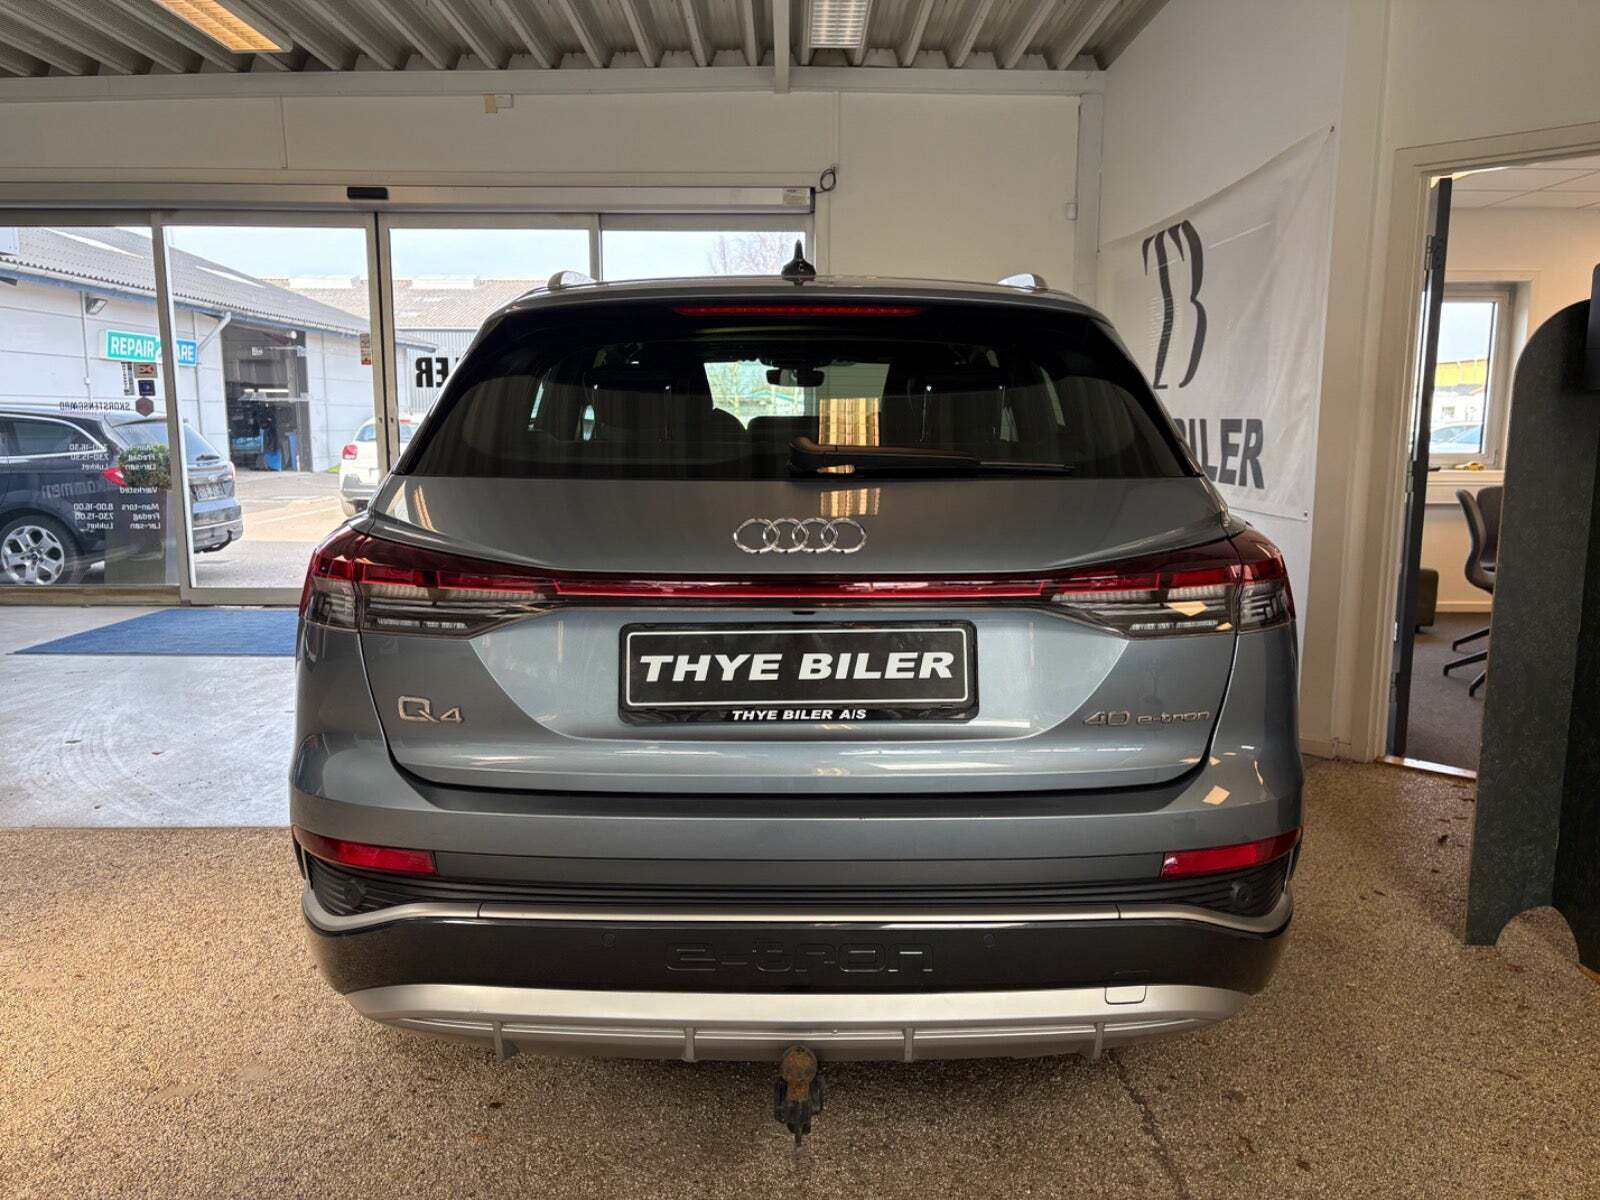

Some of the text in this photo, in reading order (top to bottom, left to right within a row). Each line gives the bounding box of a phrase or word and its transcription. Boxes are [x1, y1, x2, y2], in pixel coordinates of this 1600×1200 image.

[111, 336, 155, 358] REPAIR
[1173, 418, 1265, 489] ILER
[639, 651, 955, 683] THYE BILER
[397, 694, 464, 724] Q4
[731, 708, 868, 721] THYE BILER A/S
[1083, 709, 1210, 726] 40 e-tron
[666, 942, 935, 976] e-tron
